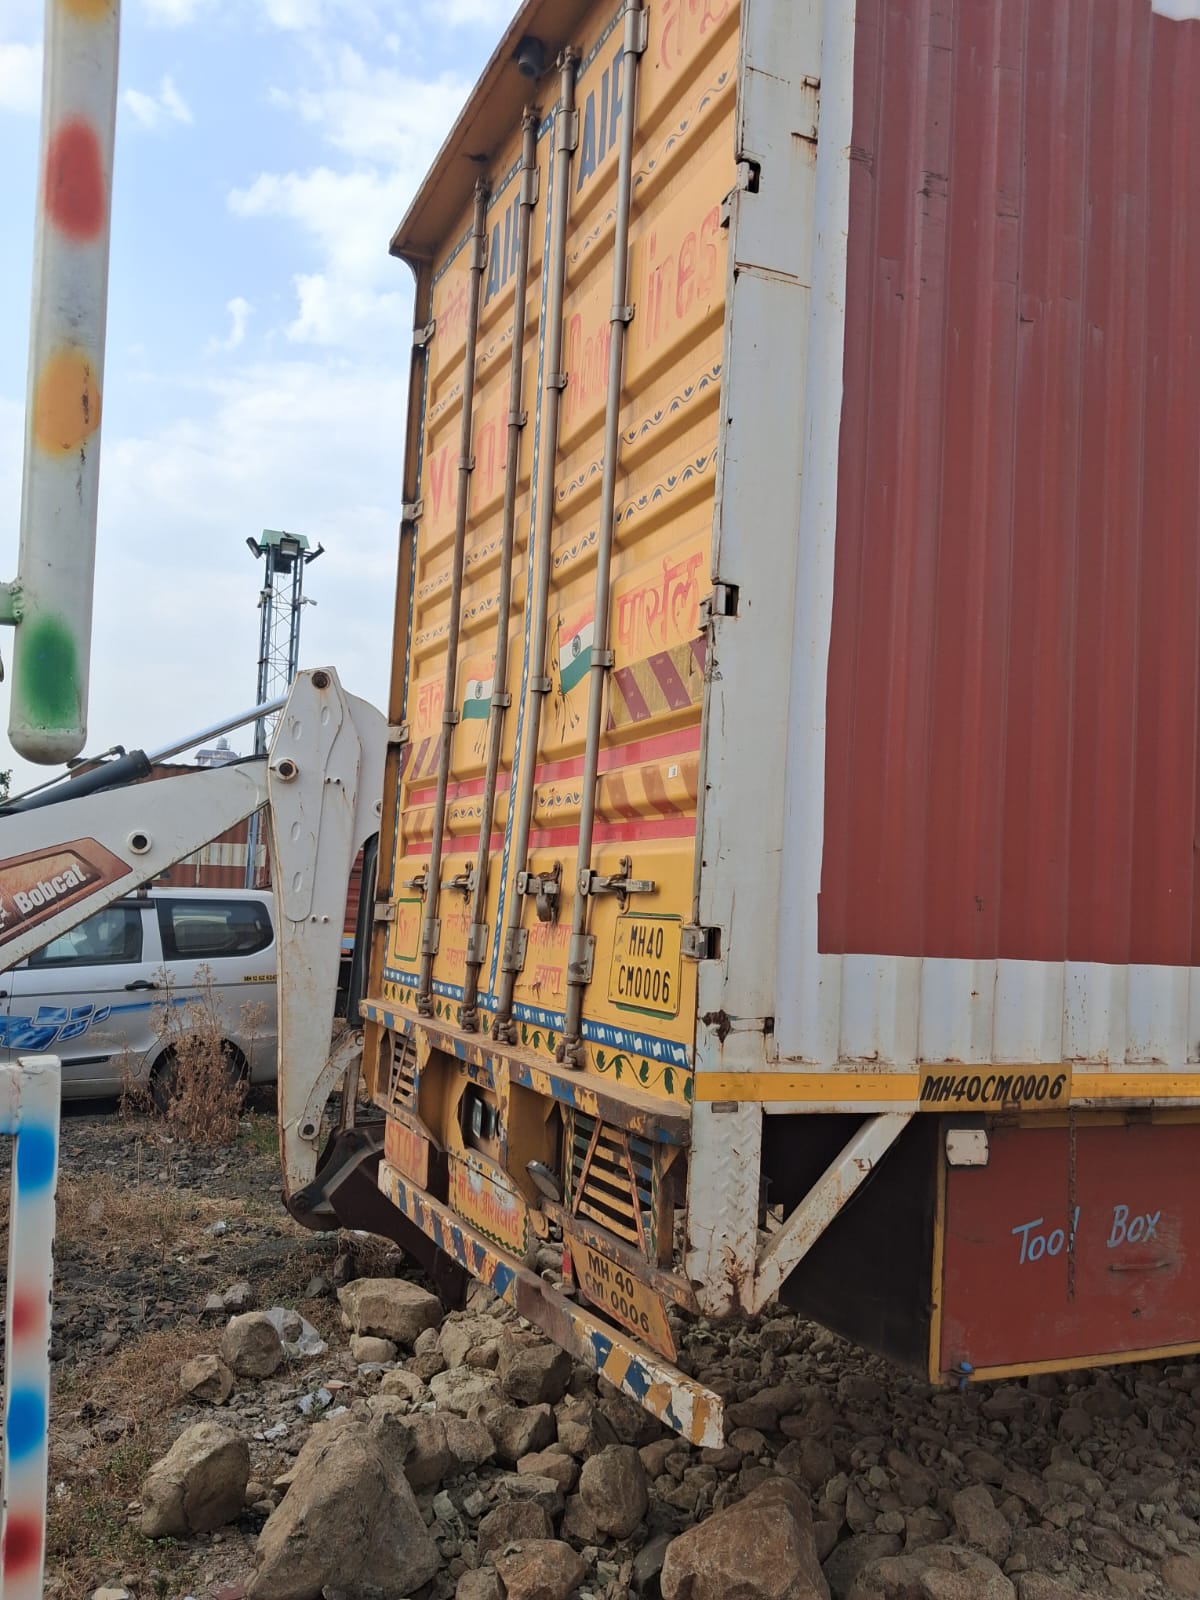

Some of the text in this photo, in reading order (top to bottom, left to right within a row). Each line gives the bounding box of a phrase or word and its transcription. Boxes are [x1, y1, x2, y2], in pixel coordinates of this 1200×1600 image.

[13, 863, 87, 914] Bobcat
[628, 924, 664, 960] MH40
[617, 964, 671, 1004] CM0006
[920, 1074, 1068, 1103] MH40CM0006
[1106, 1204, 1160, 1249] Box
[614, 1271, 634, 1299] 40
[610, 1291, 650, 1334] 0006
